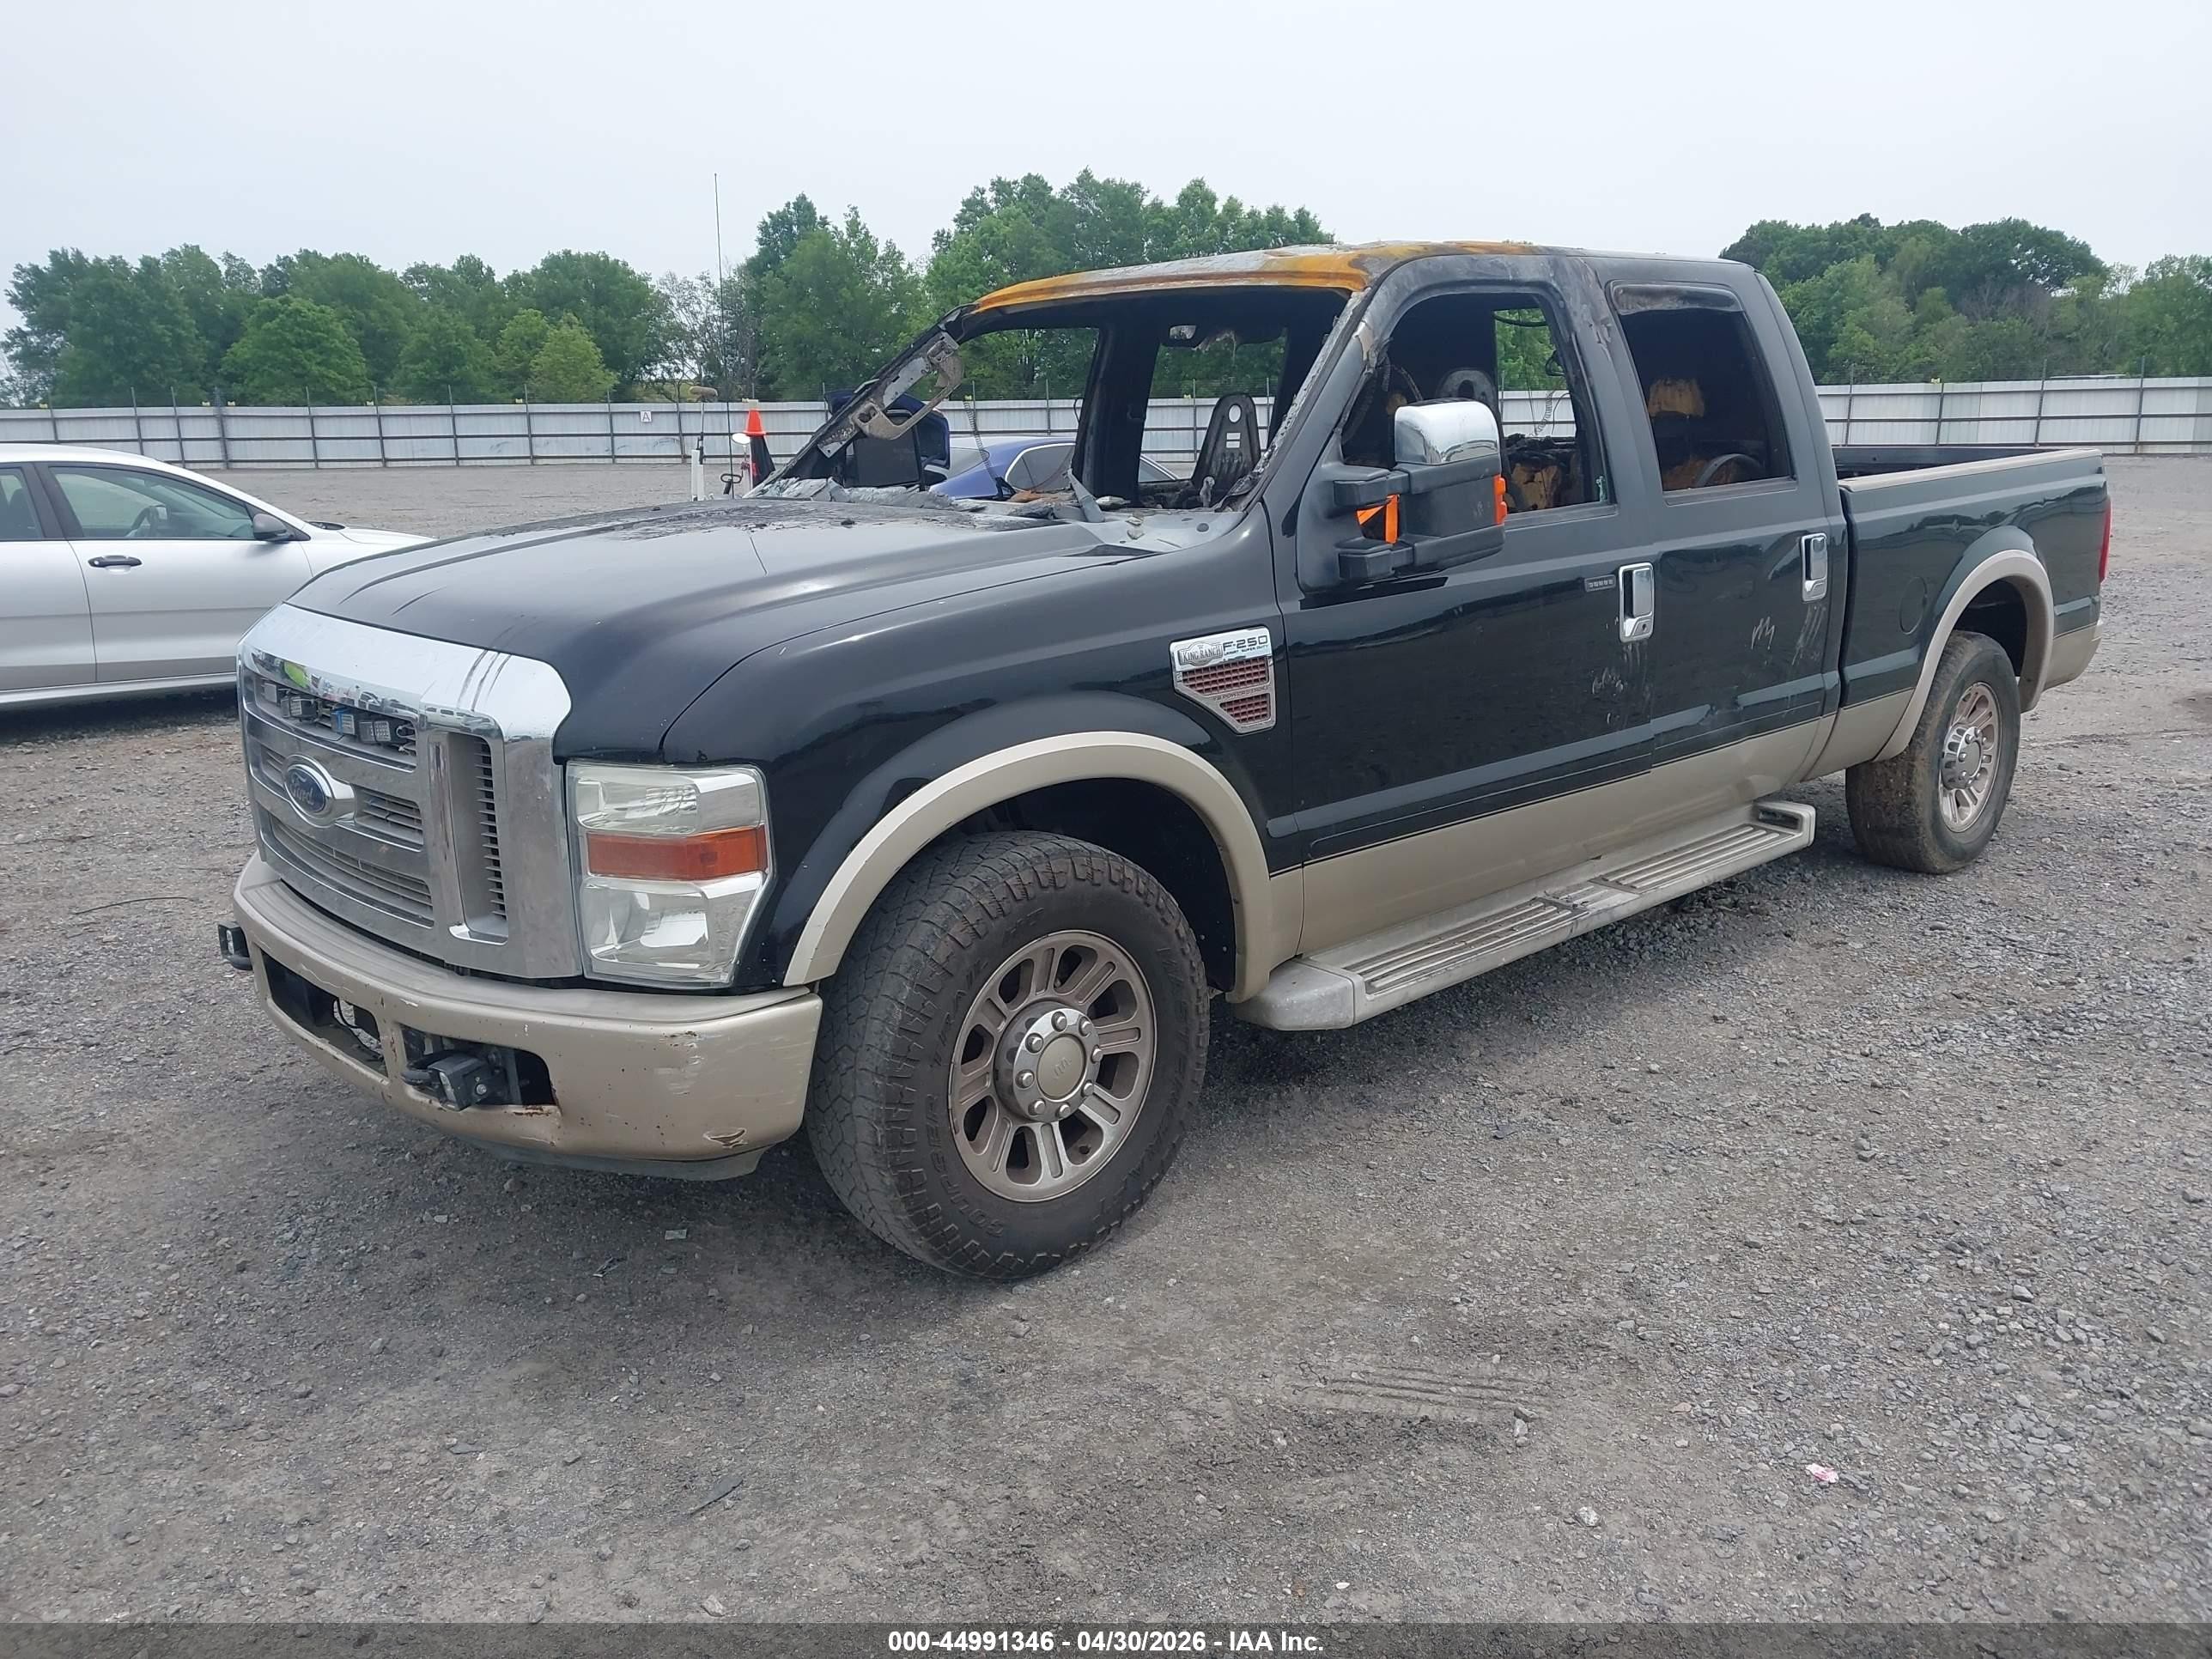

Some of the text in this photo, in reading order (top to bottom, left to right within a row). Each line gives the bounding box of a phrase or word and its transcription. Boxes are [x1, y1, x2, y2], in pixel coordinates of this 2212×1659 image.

[1223, 635, 1267, 651] F-250
[1182, 646, 1221, 662] KING RANCH
[290, 771, 316, 806] Ford
